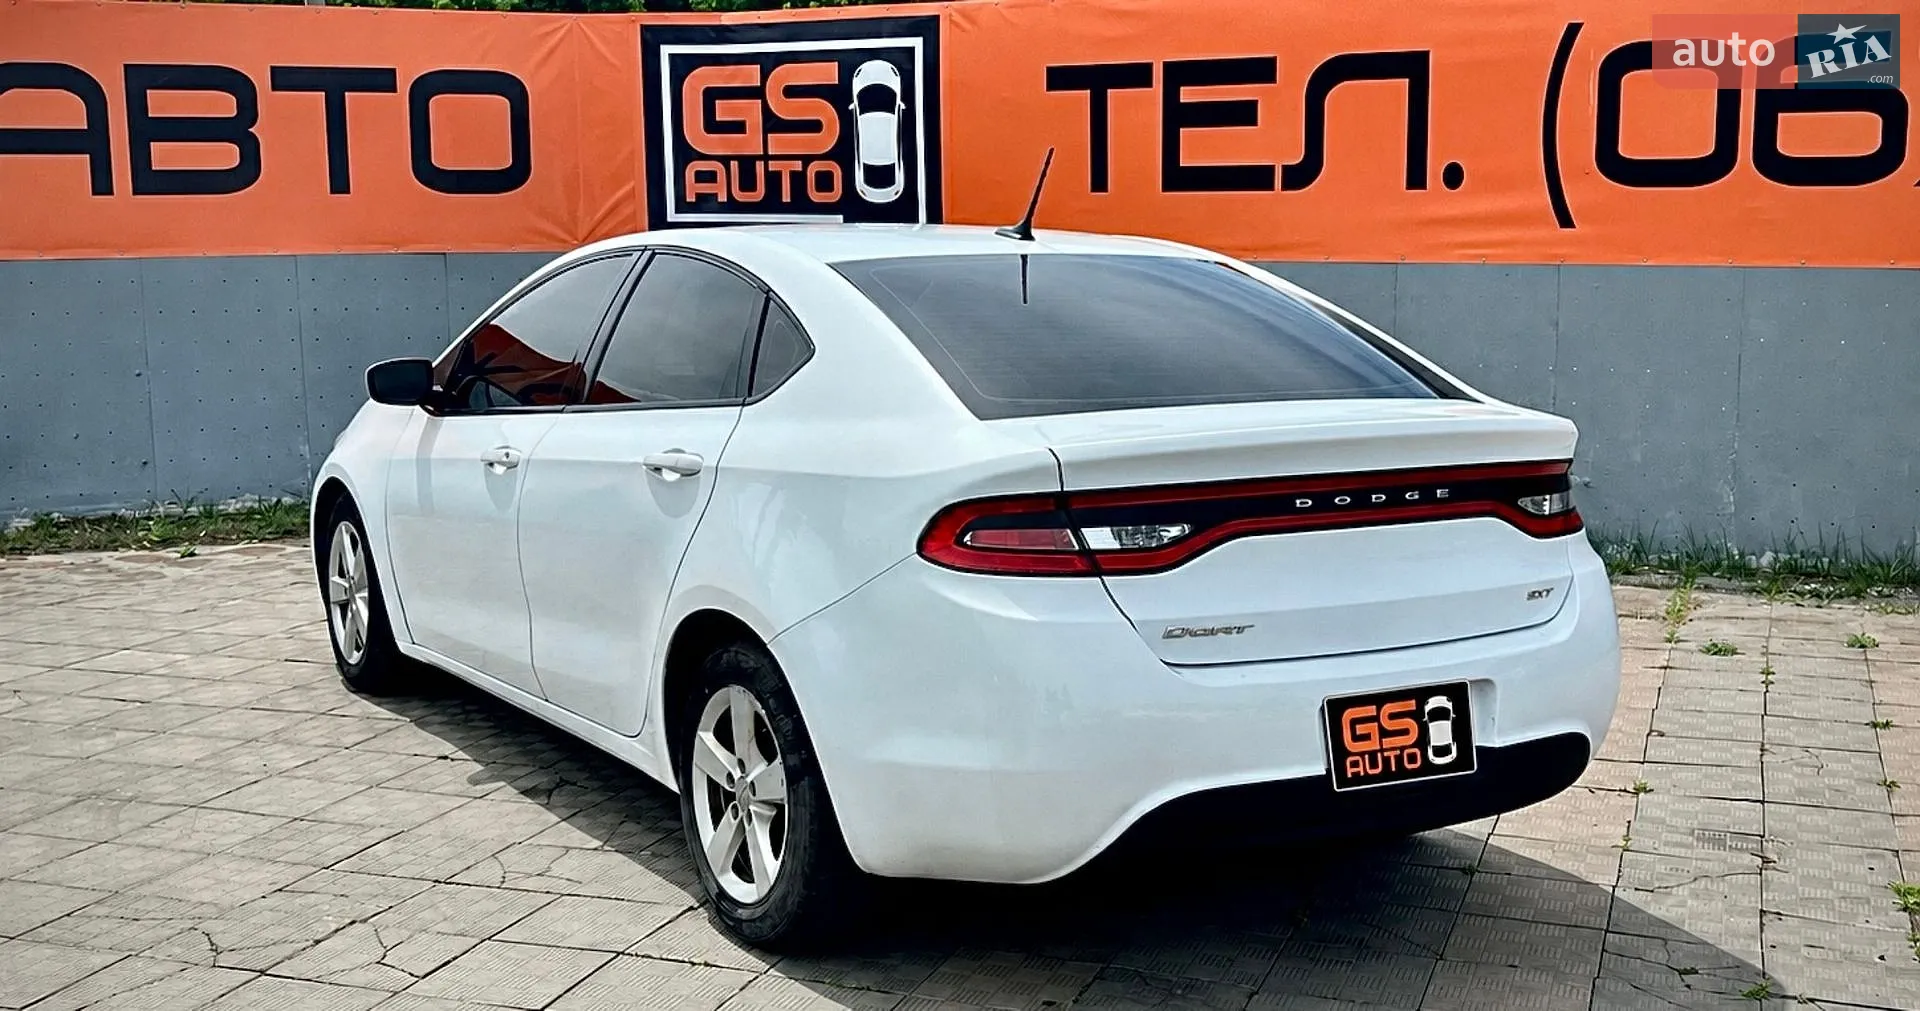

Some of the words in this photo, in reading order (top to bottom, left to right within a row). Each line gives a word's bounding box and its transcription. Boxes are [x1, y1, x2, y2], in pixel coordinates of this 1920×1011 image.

[0, 62, 532, 195] АВТО
[683, 62, 840, 155] GS
[1046, 49, 1465, 193] ТЕЛ.
[1541, 22, 1920, 229] (06
[685, 160, 842, 203] AUTO
[1295, 489, 1449, 507] DODGE
[1341, 699, 1418, 752] GS
[1346, 748, 1421, 778] AUTO
